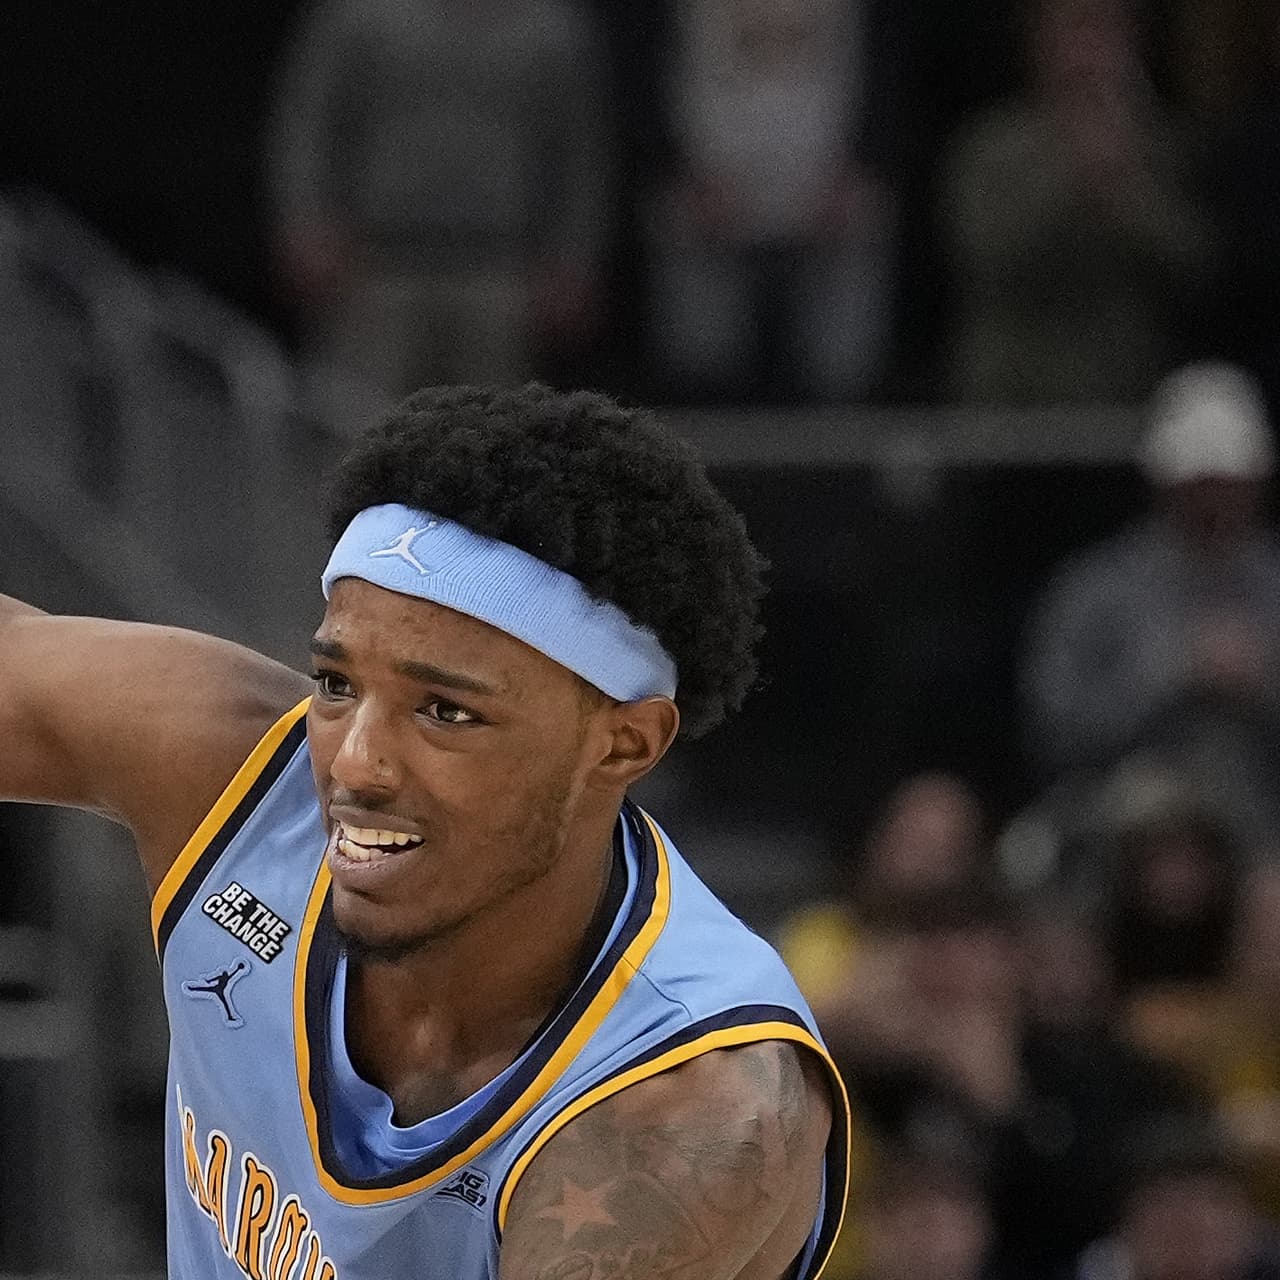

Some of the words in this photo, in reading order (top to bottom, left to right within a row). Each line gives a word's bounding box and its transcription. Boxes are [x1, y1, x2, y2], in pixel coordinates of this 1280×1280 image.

[203, 895, 280, 961] CHANGE
[221, 882, 253, 912] BE
[248, 903, 289, 942] THE
